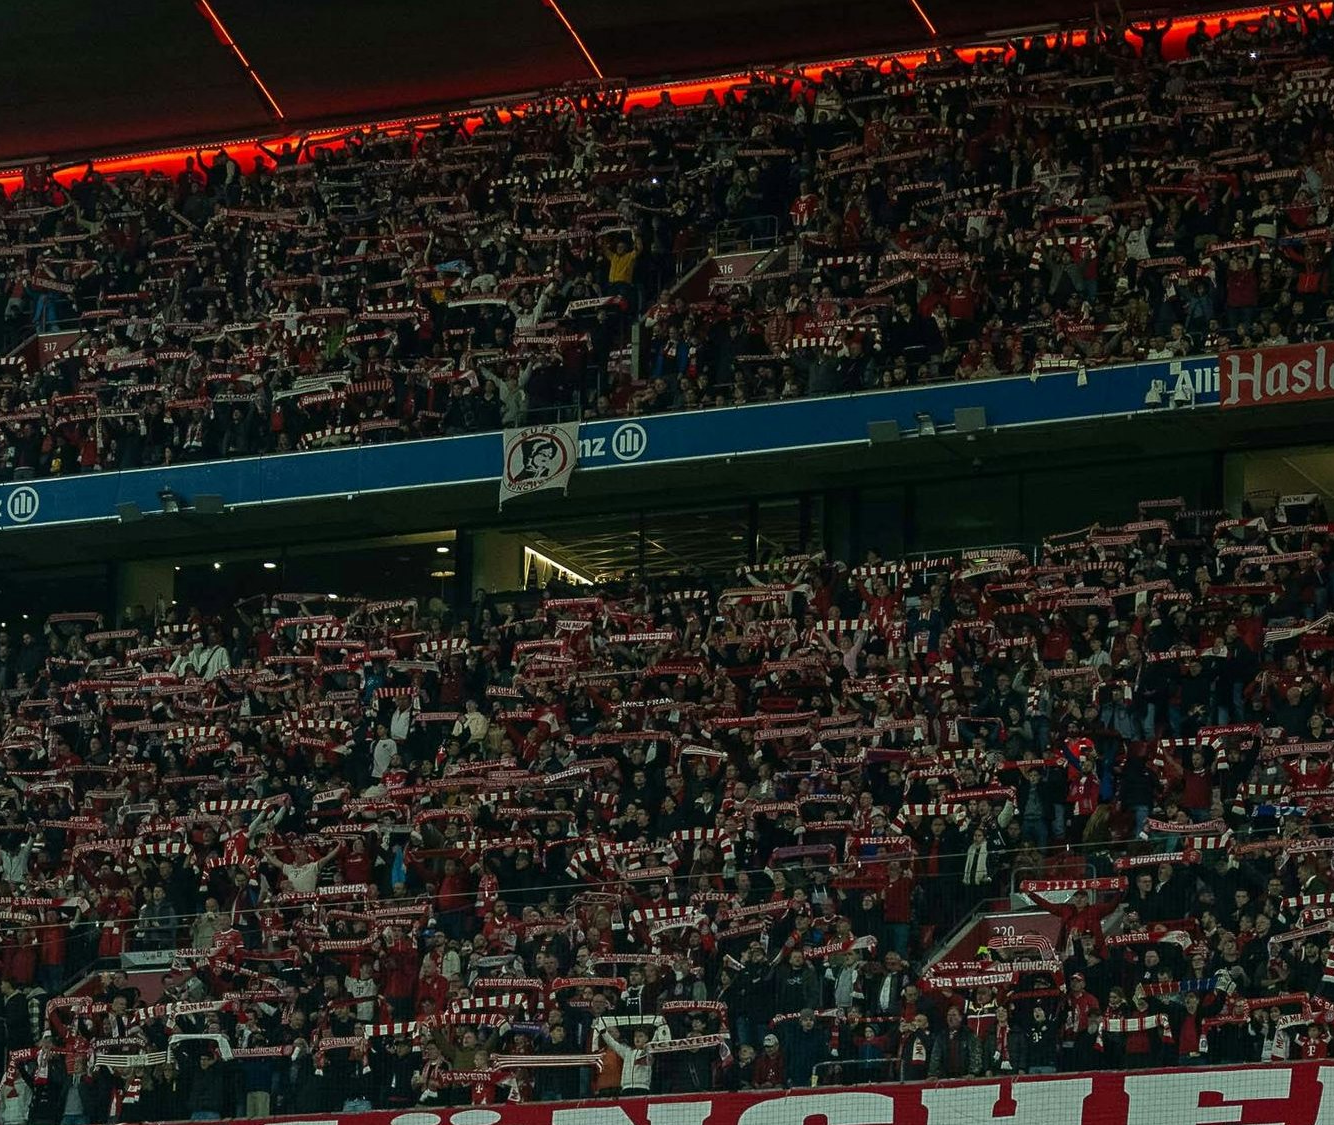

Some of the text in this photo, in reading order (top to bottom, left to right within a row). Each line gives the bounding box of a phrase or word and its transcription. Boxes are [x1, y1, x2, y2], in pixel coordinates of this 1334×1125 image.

[718, 264, 733, 274] 316
[43, 342, 58, 353] 317
[1173, 364, 1220, 396] Alli
